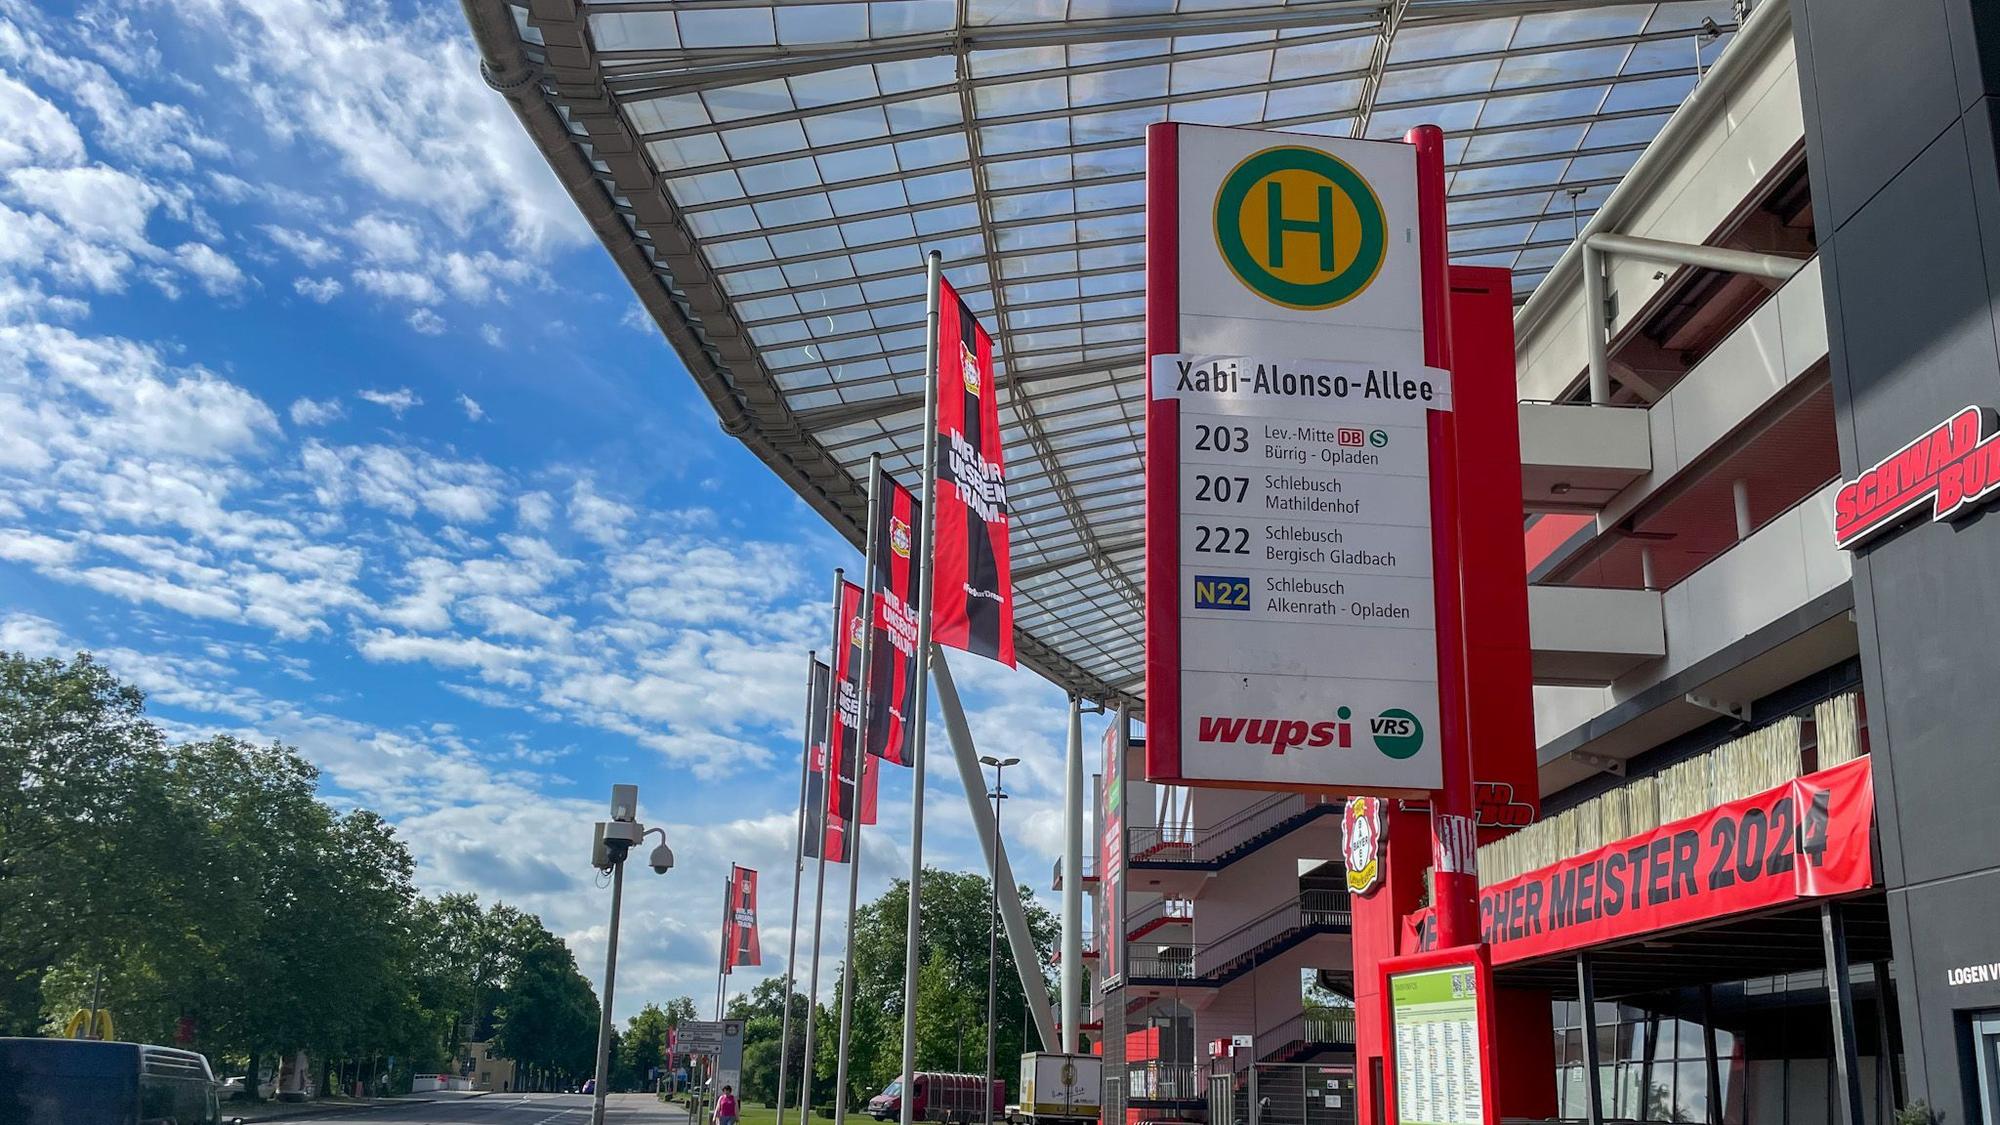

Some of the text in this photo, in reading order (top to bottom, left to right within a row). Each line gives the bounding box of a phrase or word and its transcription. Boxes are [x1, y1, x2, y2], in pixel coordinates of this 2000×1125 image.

[1267, 181, 1334, 272] H
[1176, 360, 1433, 401] Xabi-Alonso-Allee
[1195, 424, 1250, 453] 203
[1264, 425, 1335, 444] Lev.-Mitte
[1341, 431, 1362, 445] DB
[1265, 445, 1307, 464] Bürrig
[1321, 449, 1379, 466] Opladen
[1836, 410, 1979, 530] SCHWAD
[1195, 475, 1250, 503] 207
[1265, 475, 1342, 493] Schlebusch
[1265, 495, 1360, 514] Mathildenhof
[1195, 526, 1250, 554] 222
[1265, 526, 1343, 543] Schlebusch
[1266, 547, 1396, 567] Bergisch Gladbach
[1197, 582, 1249, 606] N22
[1266, 577, 1344, 595] Schlebusch
[1267, 598, 1336, 615] Alkenrath
[1351, 602, 1410, 620] Opladen
[1199, 705, 1352, 755] wupsi
[1371, 717, 1410, 736] VRS
[1550, 829, 1700, 931] MEISTER
[1708, 789, 1830, 891] 2024
[1948, 964, 1988, 986] LOGEN
